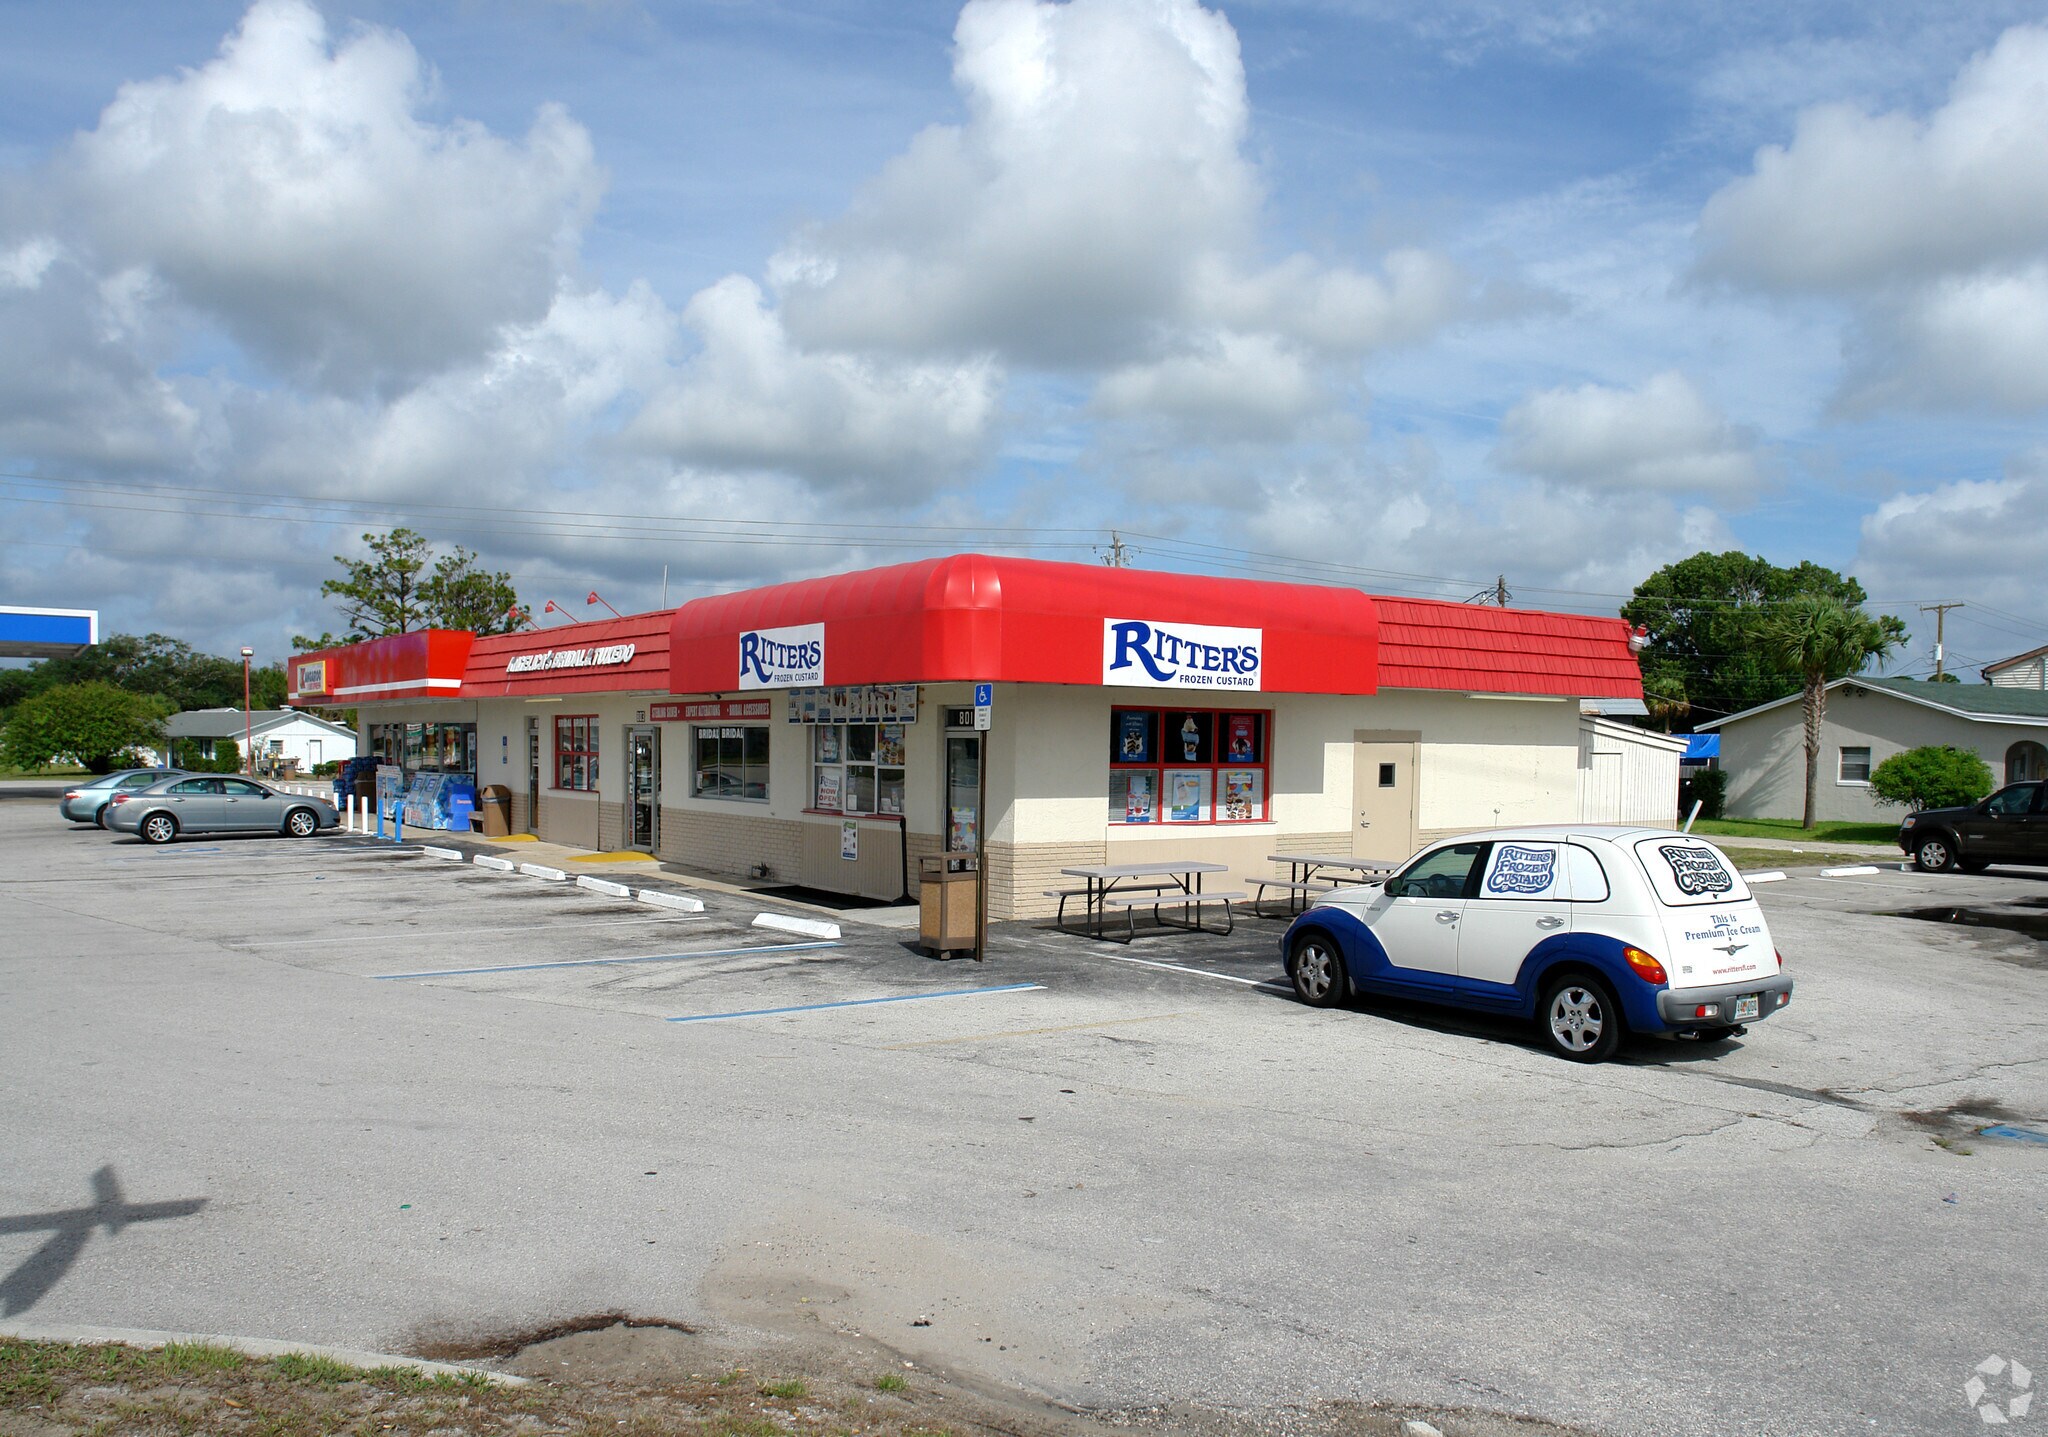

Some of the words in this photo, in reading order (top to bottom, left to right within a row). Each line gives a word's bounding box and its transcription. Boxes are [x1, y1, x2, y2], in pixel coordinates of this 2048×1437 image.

[551, 649, 586, 668] BRIDAL
[592, 643, 635, 666] TUXEDO
[740, 632, 822, 684] RITTER'S
[1109, 621, 1260, 682] RITTER'S
[774, 674, 794, 683] FROZEN
[794, 672, 819, 682] CUSTARD
[1179, 674, 1213, 685] FROZEN
[1216, 676, 1255, 687] CUSTARD
[959, 711, 973, 725] 801
[698, 728, 719, 739] BRIDAL
[721, 727, 743, 739] BRIDAL
[818, 794, 837, 802] OPEN
[820, 787, 837, 795] NOW
[1497, 860, 1550, 874] FROZEN
[1672, 859, 1719, 873] FROZEN
[1491, 873, 1549, 887] CUSTARD
[1681, 871, 1728, 889] CUSTARD
[1710, 914, 1729, 924] This
[1685, 930, 1725, 940] Premium
[1726, 927, 1738, 936] Ice
[1739, 925, 1761, 935] Cream
